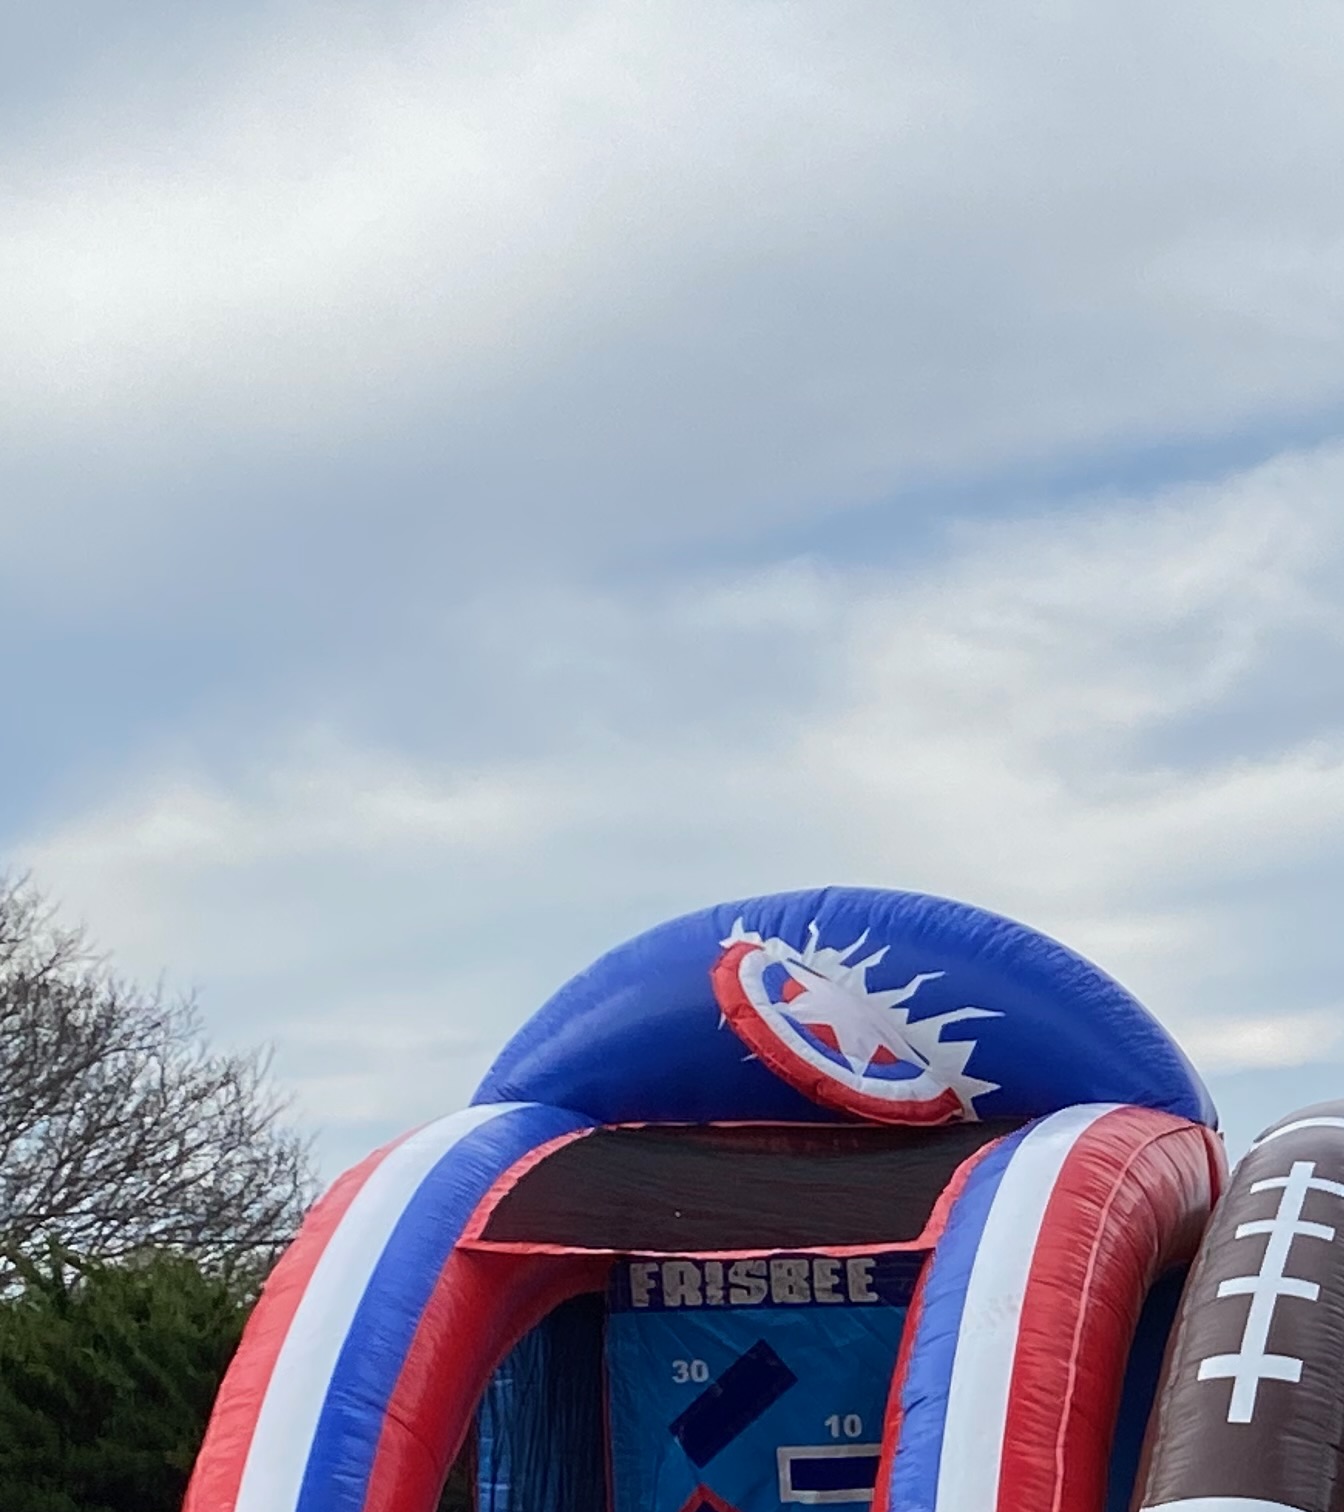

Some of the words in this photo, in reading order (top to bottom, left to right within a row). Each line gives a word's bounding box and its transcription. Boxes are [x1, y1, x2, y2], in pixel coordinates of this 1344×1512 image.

[630, 1259, 880, 1306] FRISBEE
[671, 1360, 710, 1383] 30
[825, 1414, 862, 1439] 10
